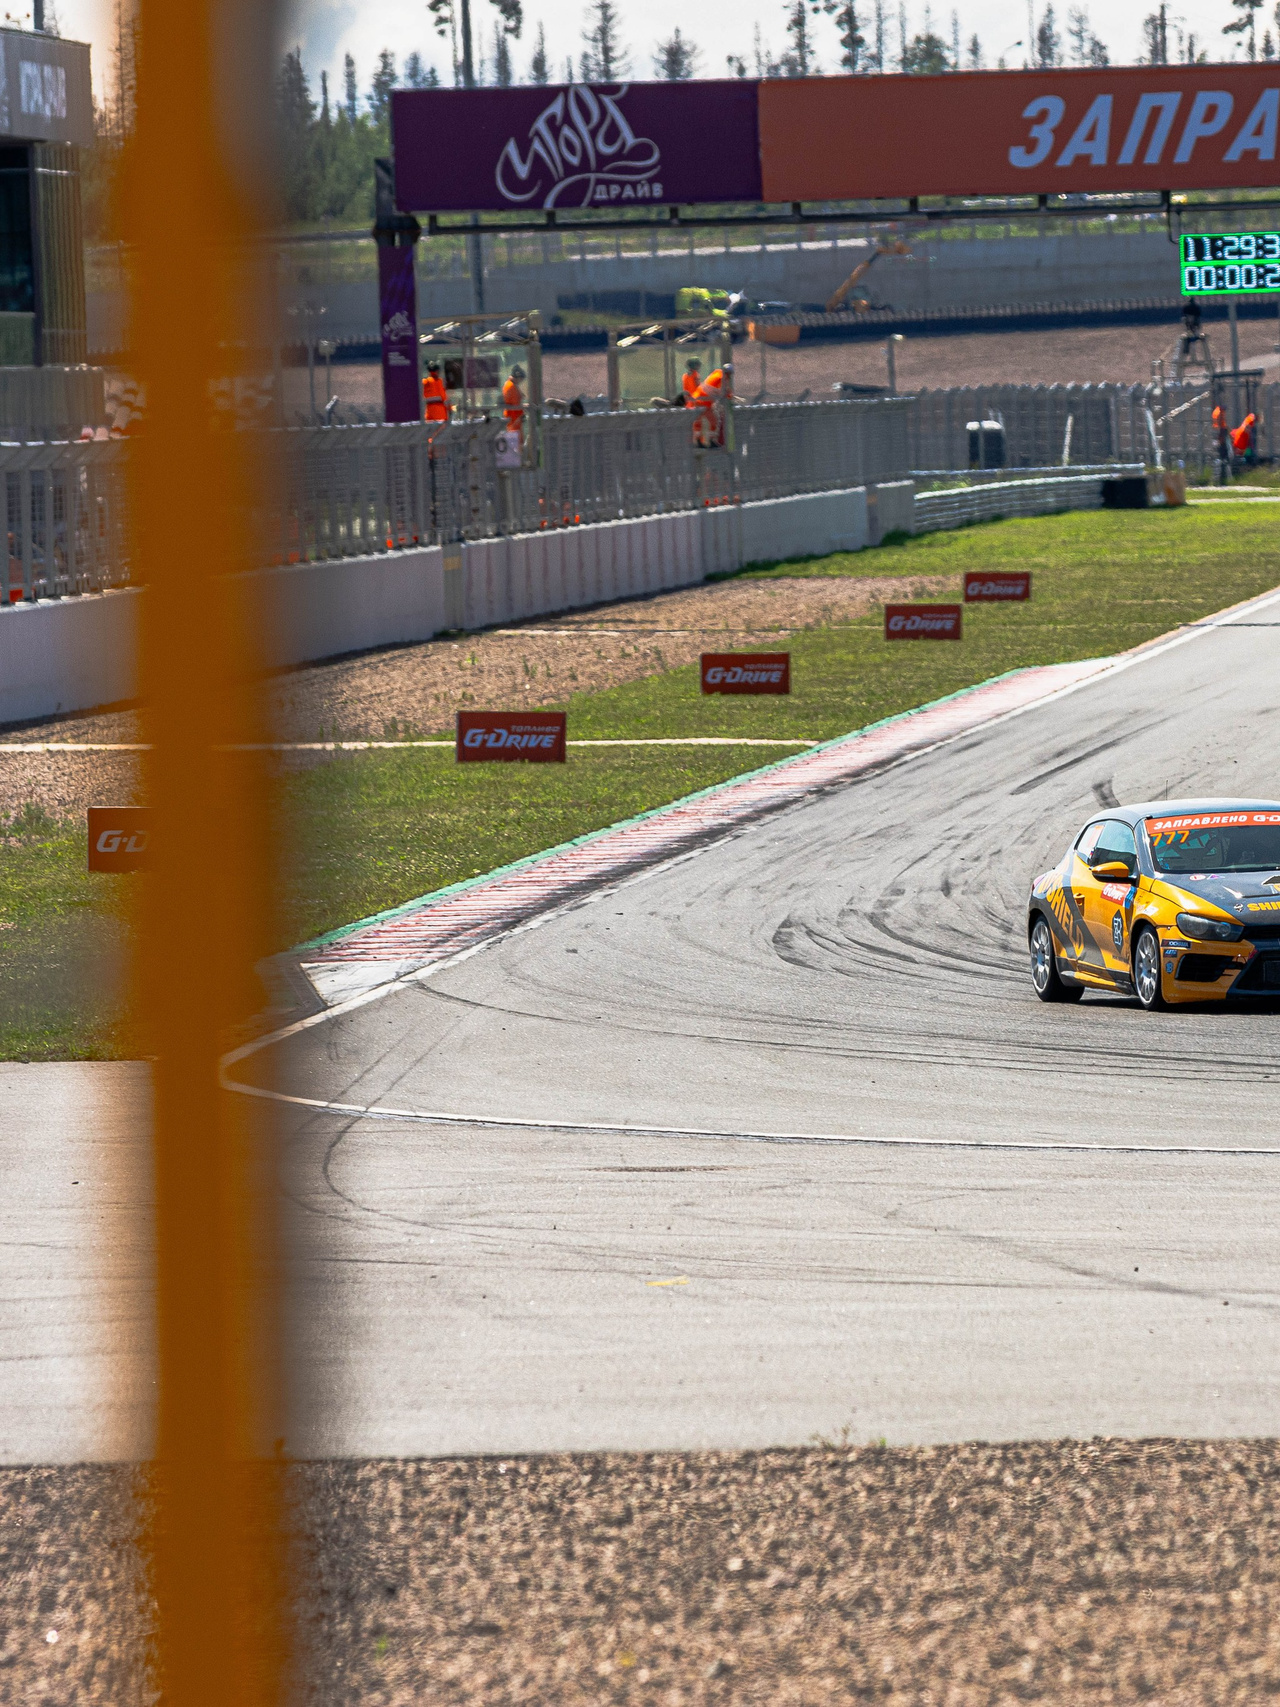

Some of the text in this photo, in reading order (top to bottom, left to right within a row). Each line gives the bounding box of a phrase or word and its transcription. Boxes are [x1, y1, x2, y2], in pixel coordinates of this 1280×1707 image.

[594, 180, 663, 200] ДРАЙВ
[1153, 814, 1248, 830] ЗАПРАВЛЕНО
[1150, 830, 1190, 847] 777
